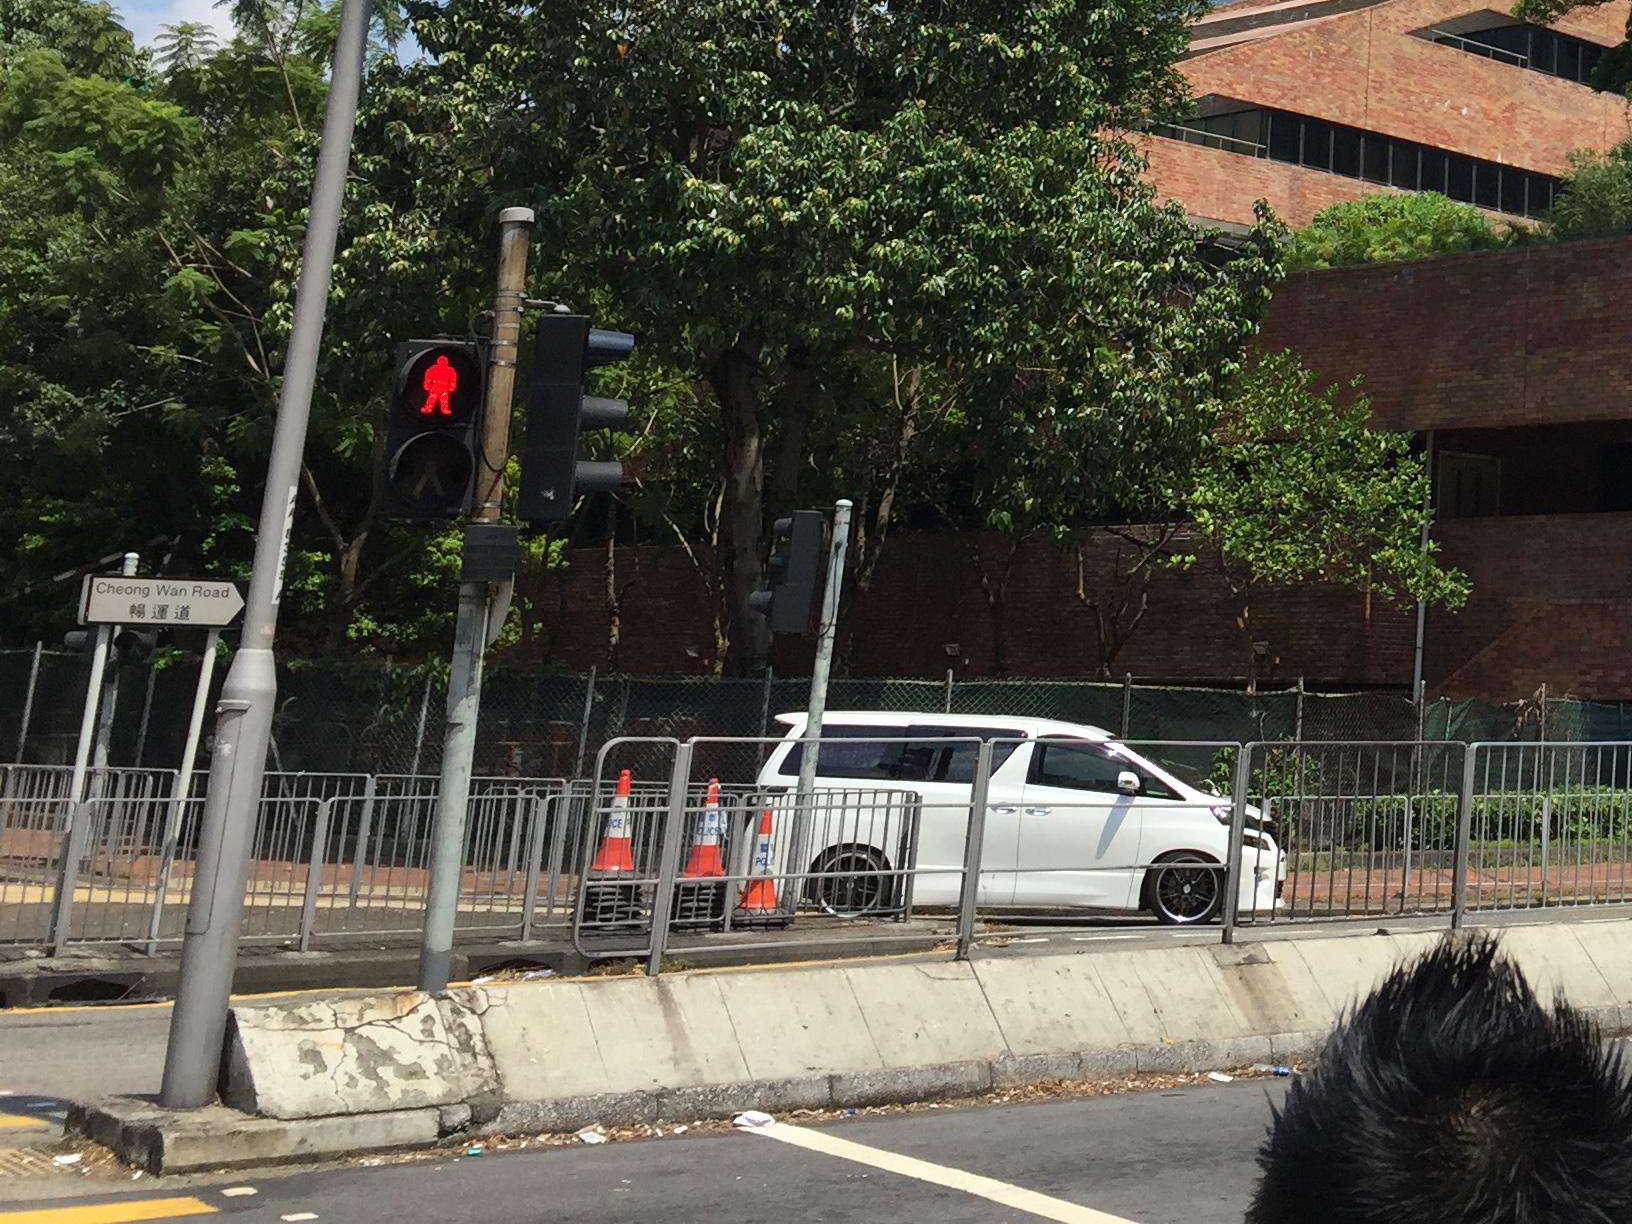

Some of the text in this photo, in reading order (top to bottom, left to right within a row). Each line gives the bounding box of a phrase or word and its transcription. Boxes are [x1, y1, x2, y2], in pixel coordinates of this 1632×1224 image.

[96, 582, 230, 598] Cheong Wan Road
[129, 603, 191, 621] 暢運道
